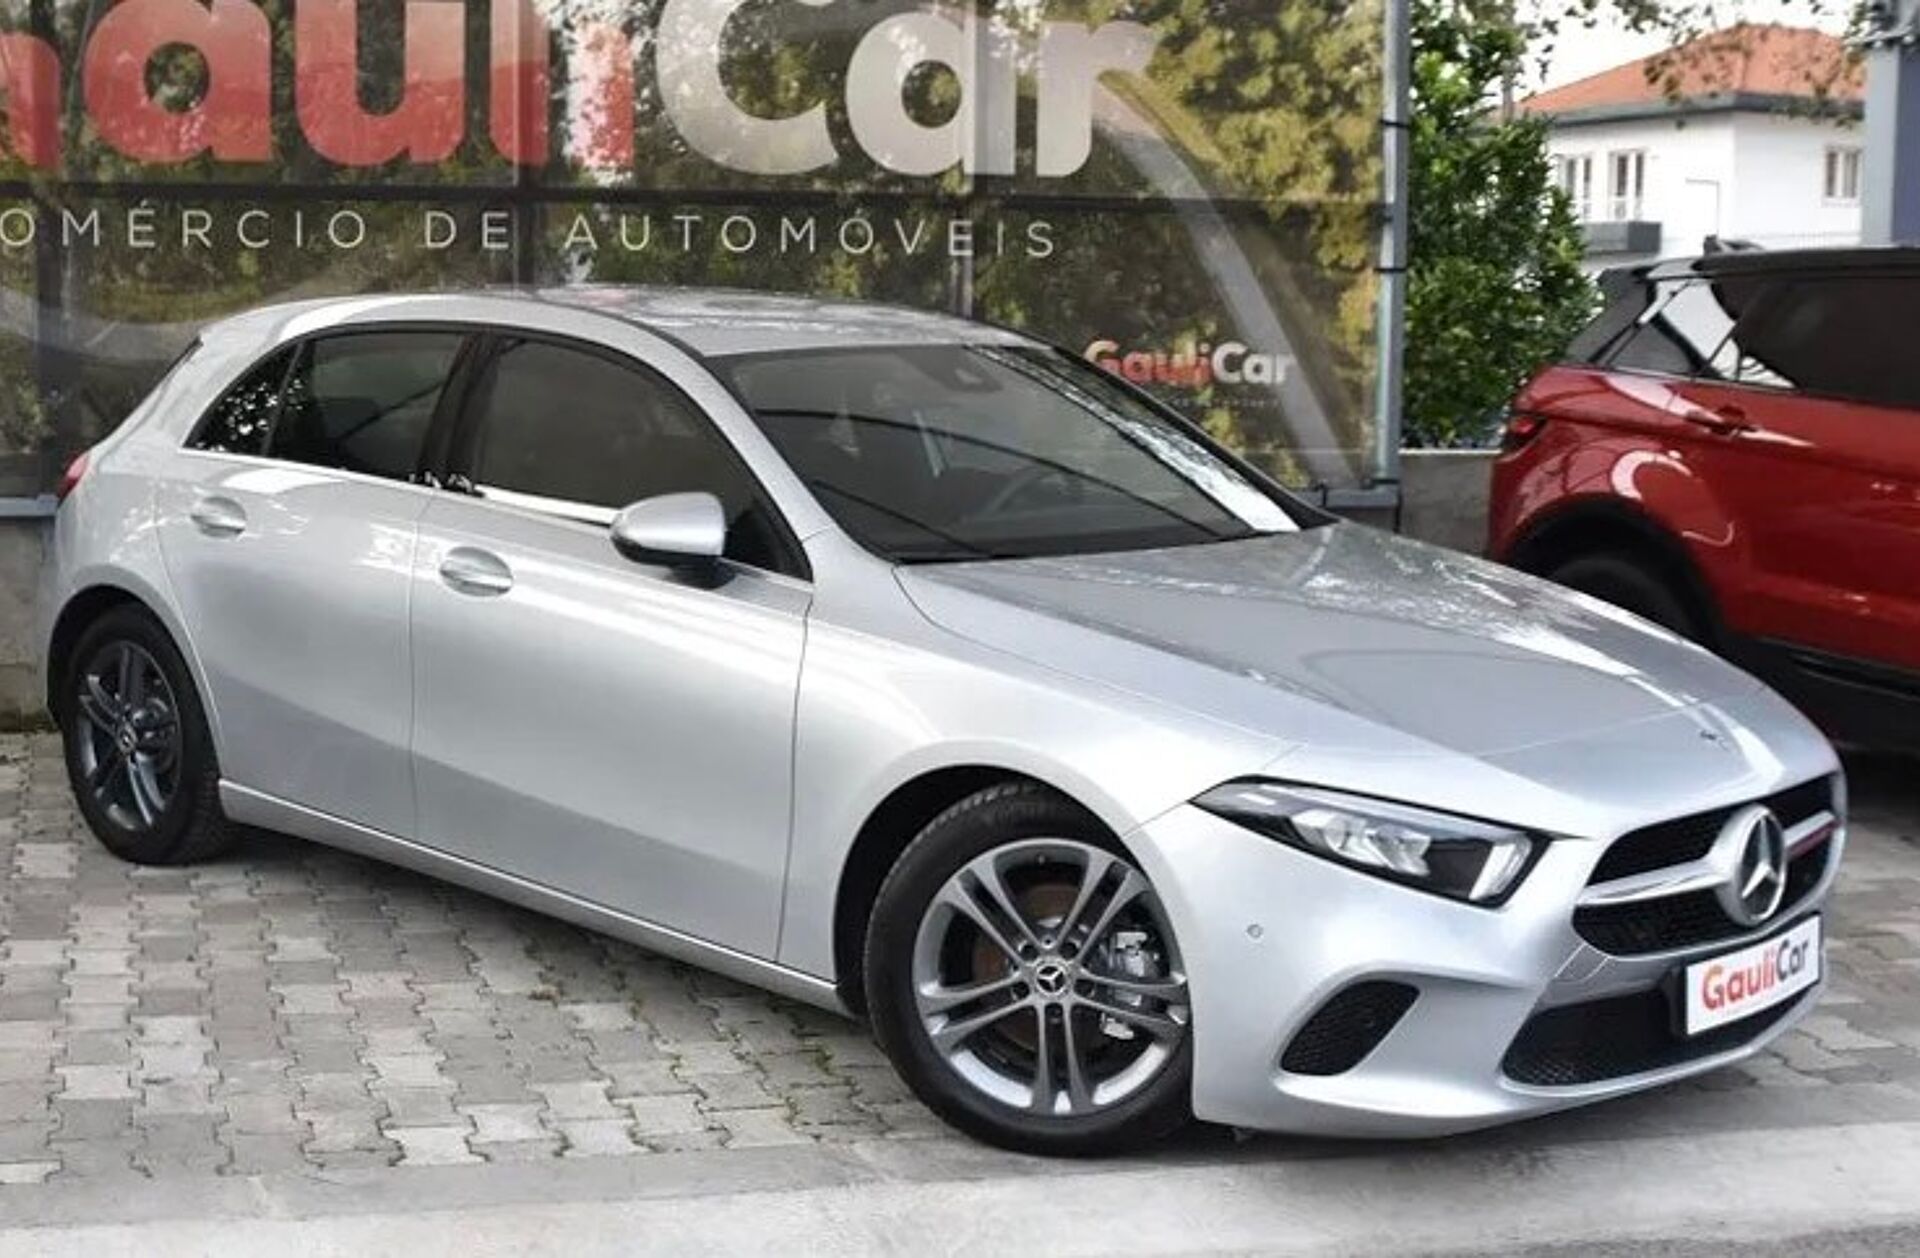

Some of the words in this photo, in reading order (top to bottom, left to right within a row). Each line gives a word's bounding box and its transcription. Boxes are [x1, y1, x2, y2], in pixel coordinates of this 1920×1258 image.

[424, 211, 509, 249] DE
[565, 206, 1055, 258] AUTOMÓVEIS
[1084, 339, 1294, 385] GauliCar
[1702, 939, 1809, 1010] GauliCar
